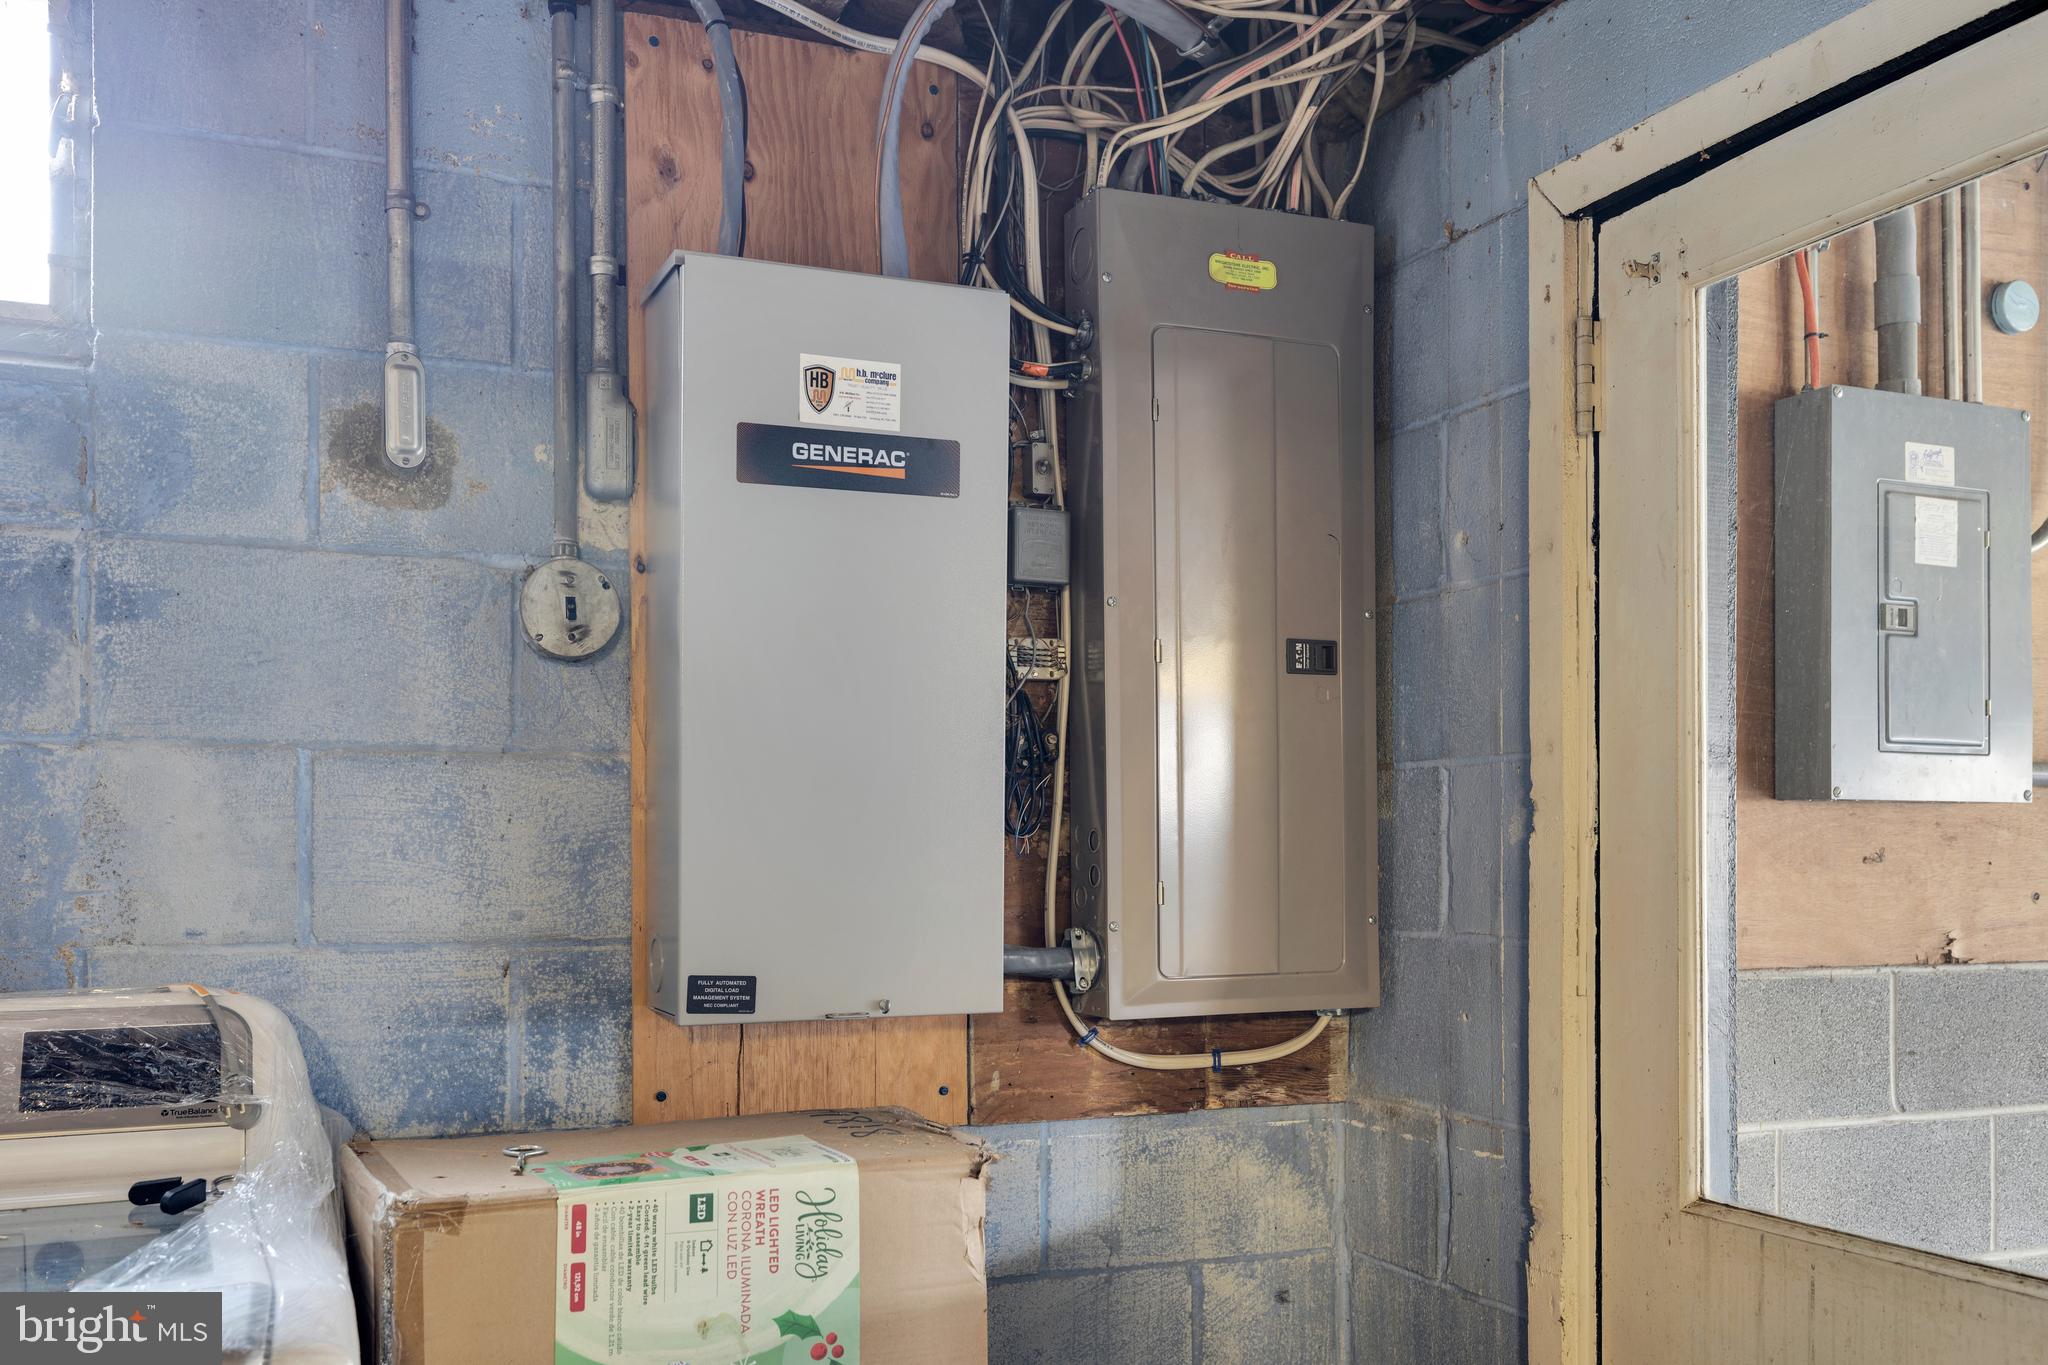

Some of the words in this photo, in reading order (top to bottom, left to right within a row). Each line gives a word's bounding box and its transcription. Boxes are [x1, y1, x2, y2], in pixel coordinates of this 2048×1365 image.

[810, 370, 828, 388] HB
[792, 442, 906, 467] GENERAC
[652, 1204, 658, 1213] 40
[697, 1197, 706, 1219] LED
[727, 1192, 738, 1222] CON
[769, 1188, 779, 1213] LED
[602, 1225, 608, 1233] de
[741, 1190, 751, 1252] CORONA
[755, 1190, 766, 1246] WREATH
[593, 1232, 600, 1241] de
[727, 1227, 737, 1250] LUZ
[769, 1217, 778, 1274] LIGHTED
[794, 1188, 844, 1280] Holiday
[795, 1224, 805, 1261] LIVING
[618, 1252, 624, 1260] de
[727, 1255, 737, 1280] LED
[617, 1278, 624, 1286] de
[740, 1256, 751, 1334] ILUMINADA
